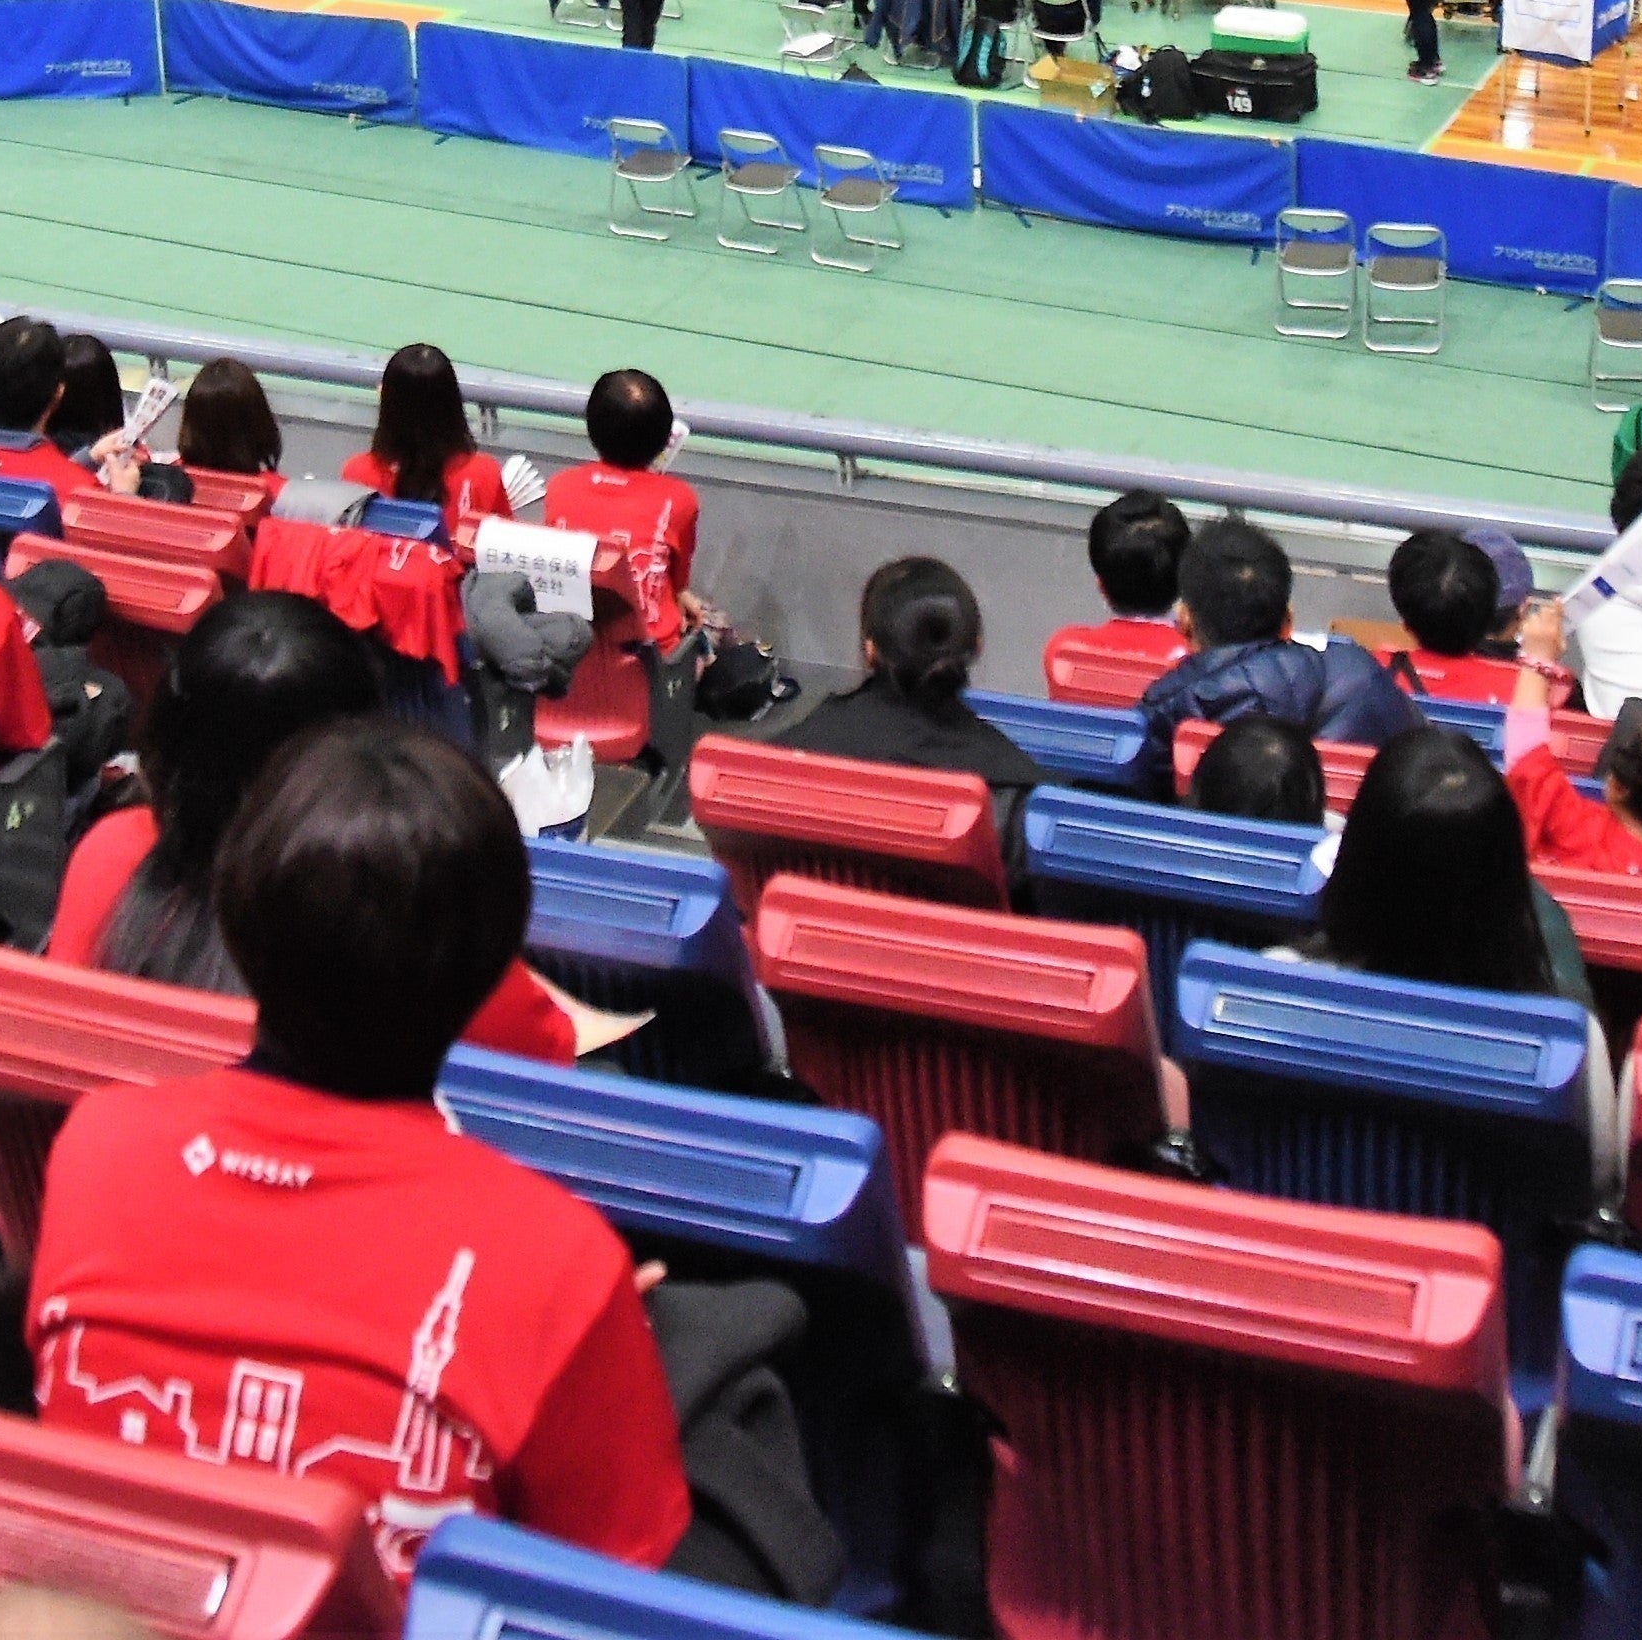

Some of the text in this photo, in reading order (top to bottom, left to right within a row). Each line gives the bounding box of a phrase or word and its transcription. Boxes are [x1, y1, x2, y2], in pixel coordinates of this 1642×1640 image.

[486, 547, 580, 578] 日本生命保険
